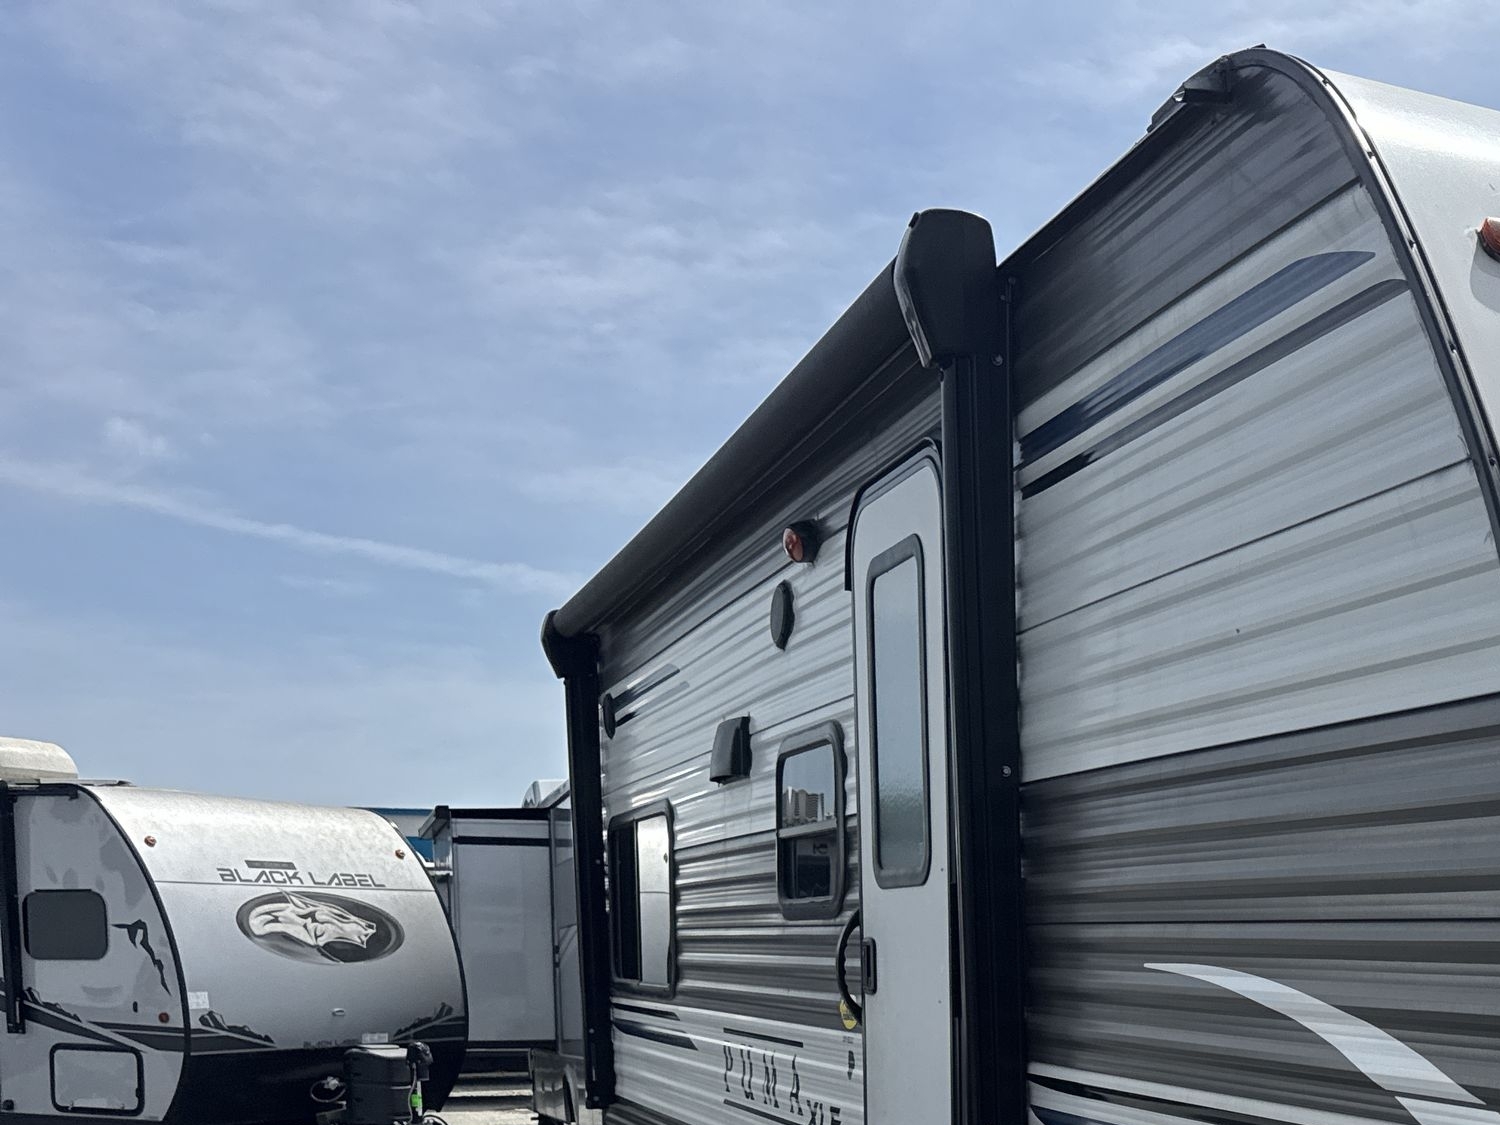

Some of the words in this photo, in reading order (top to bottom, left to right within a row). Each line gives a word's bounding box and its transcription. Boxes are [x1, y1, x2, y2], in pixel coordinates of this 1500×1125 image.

[216, 867, 304, 885] BLACK
[308, 871, 386, 888] LABEL
[723, 1040, 804, 1117] PUMA
